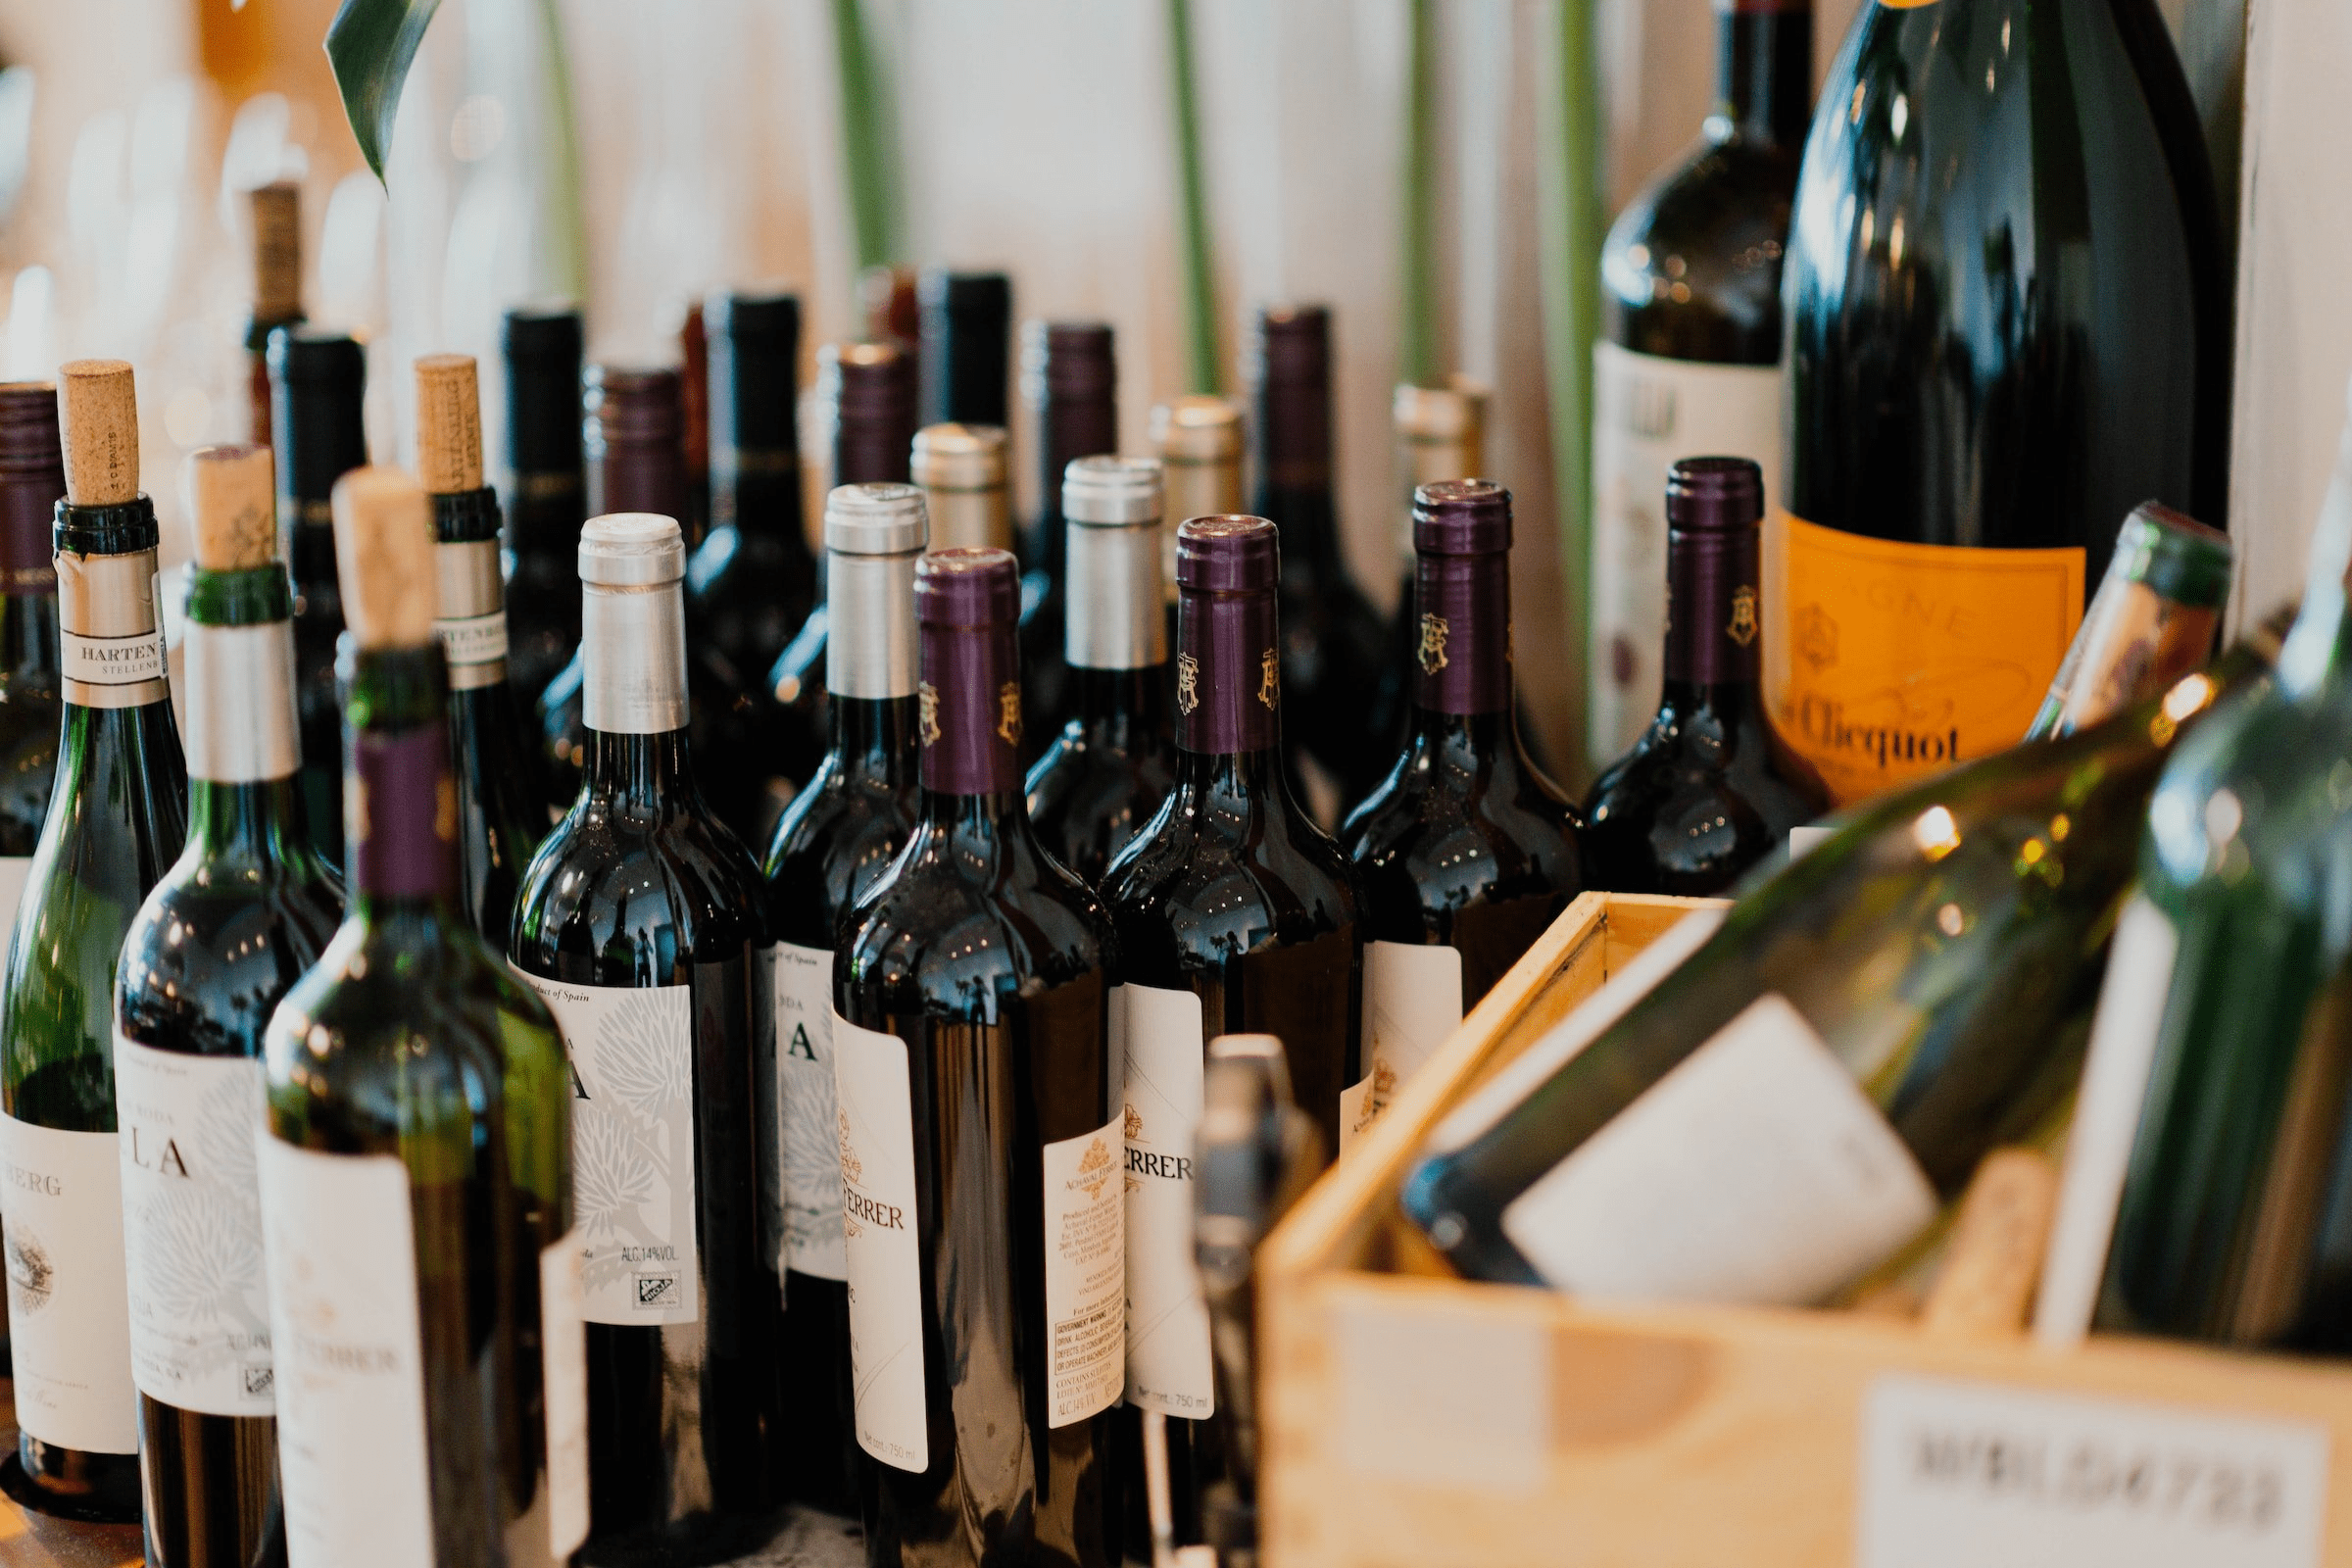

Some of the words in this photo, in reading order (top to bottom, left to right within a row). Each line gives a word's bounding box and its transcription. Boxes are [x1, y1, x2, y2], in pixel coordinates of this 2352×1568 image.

[80, 643, 157, 662] HARTEN
[552, 988, 563, 1000] of
[564, 991, 590, 1003] Spain
